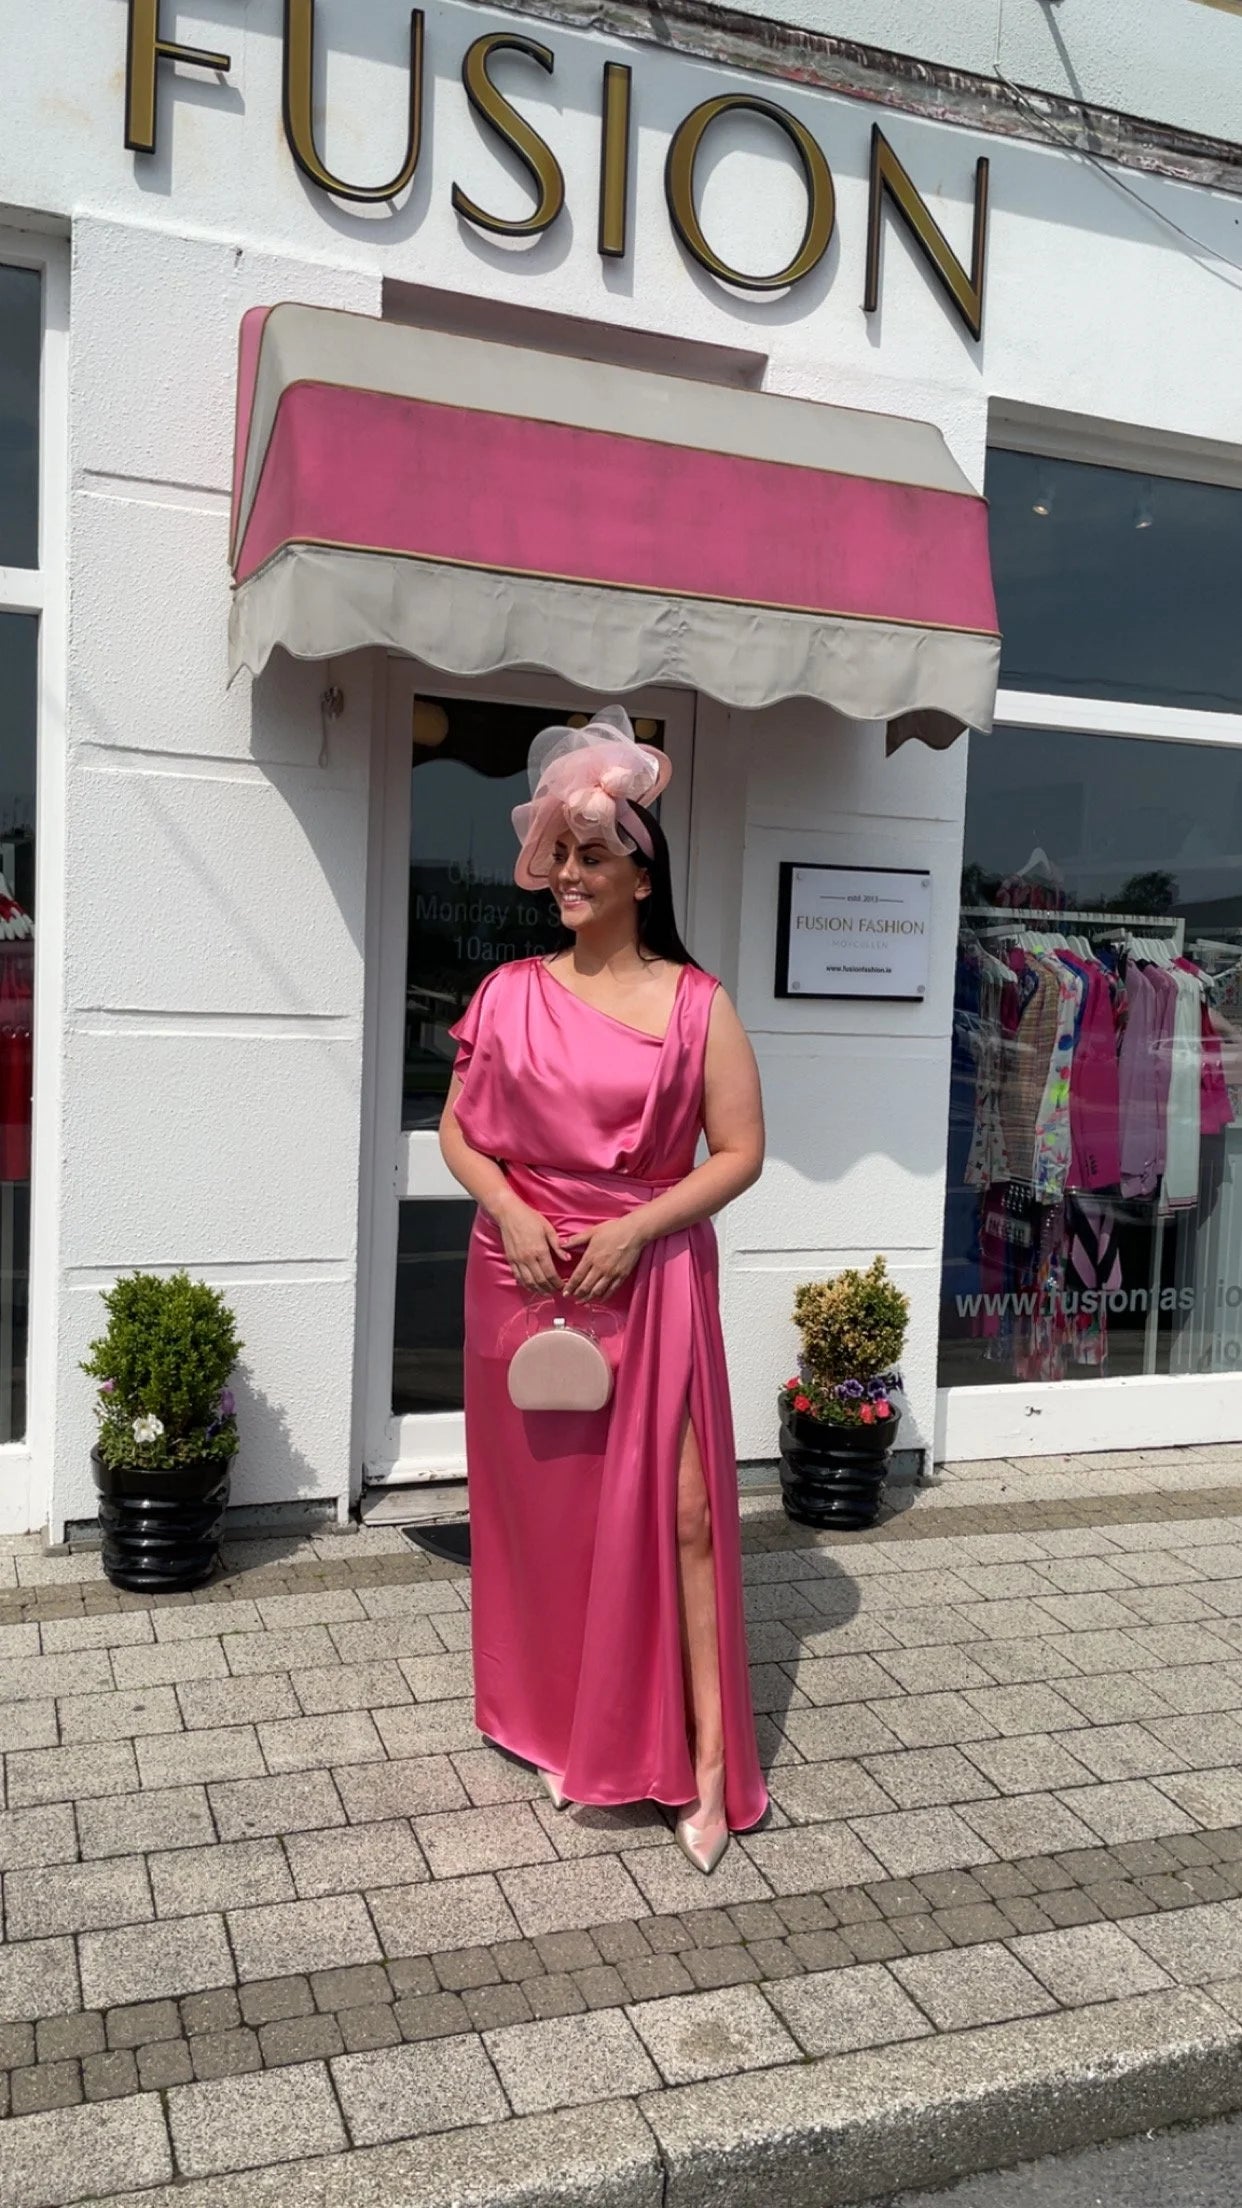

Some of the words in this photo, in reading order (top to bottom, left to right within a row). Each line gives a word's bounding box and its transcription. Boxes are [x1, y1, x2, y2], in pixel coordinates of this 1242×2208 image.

[124, 0, 990, 341] FUSION
[416, 895, 509, 929] Monday
[517, 902, 538, 926] to
[796, 916, 853, 932] FUSION
[859, 918, 925, 935] FASHION
[454, 935, 516, 961] 10am
